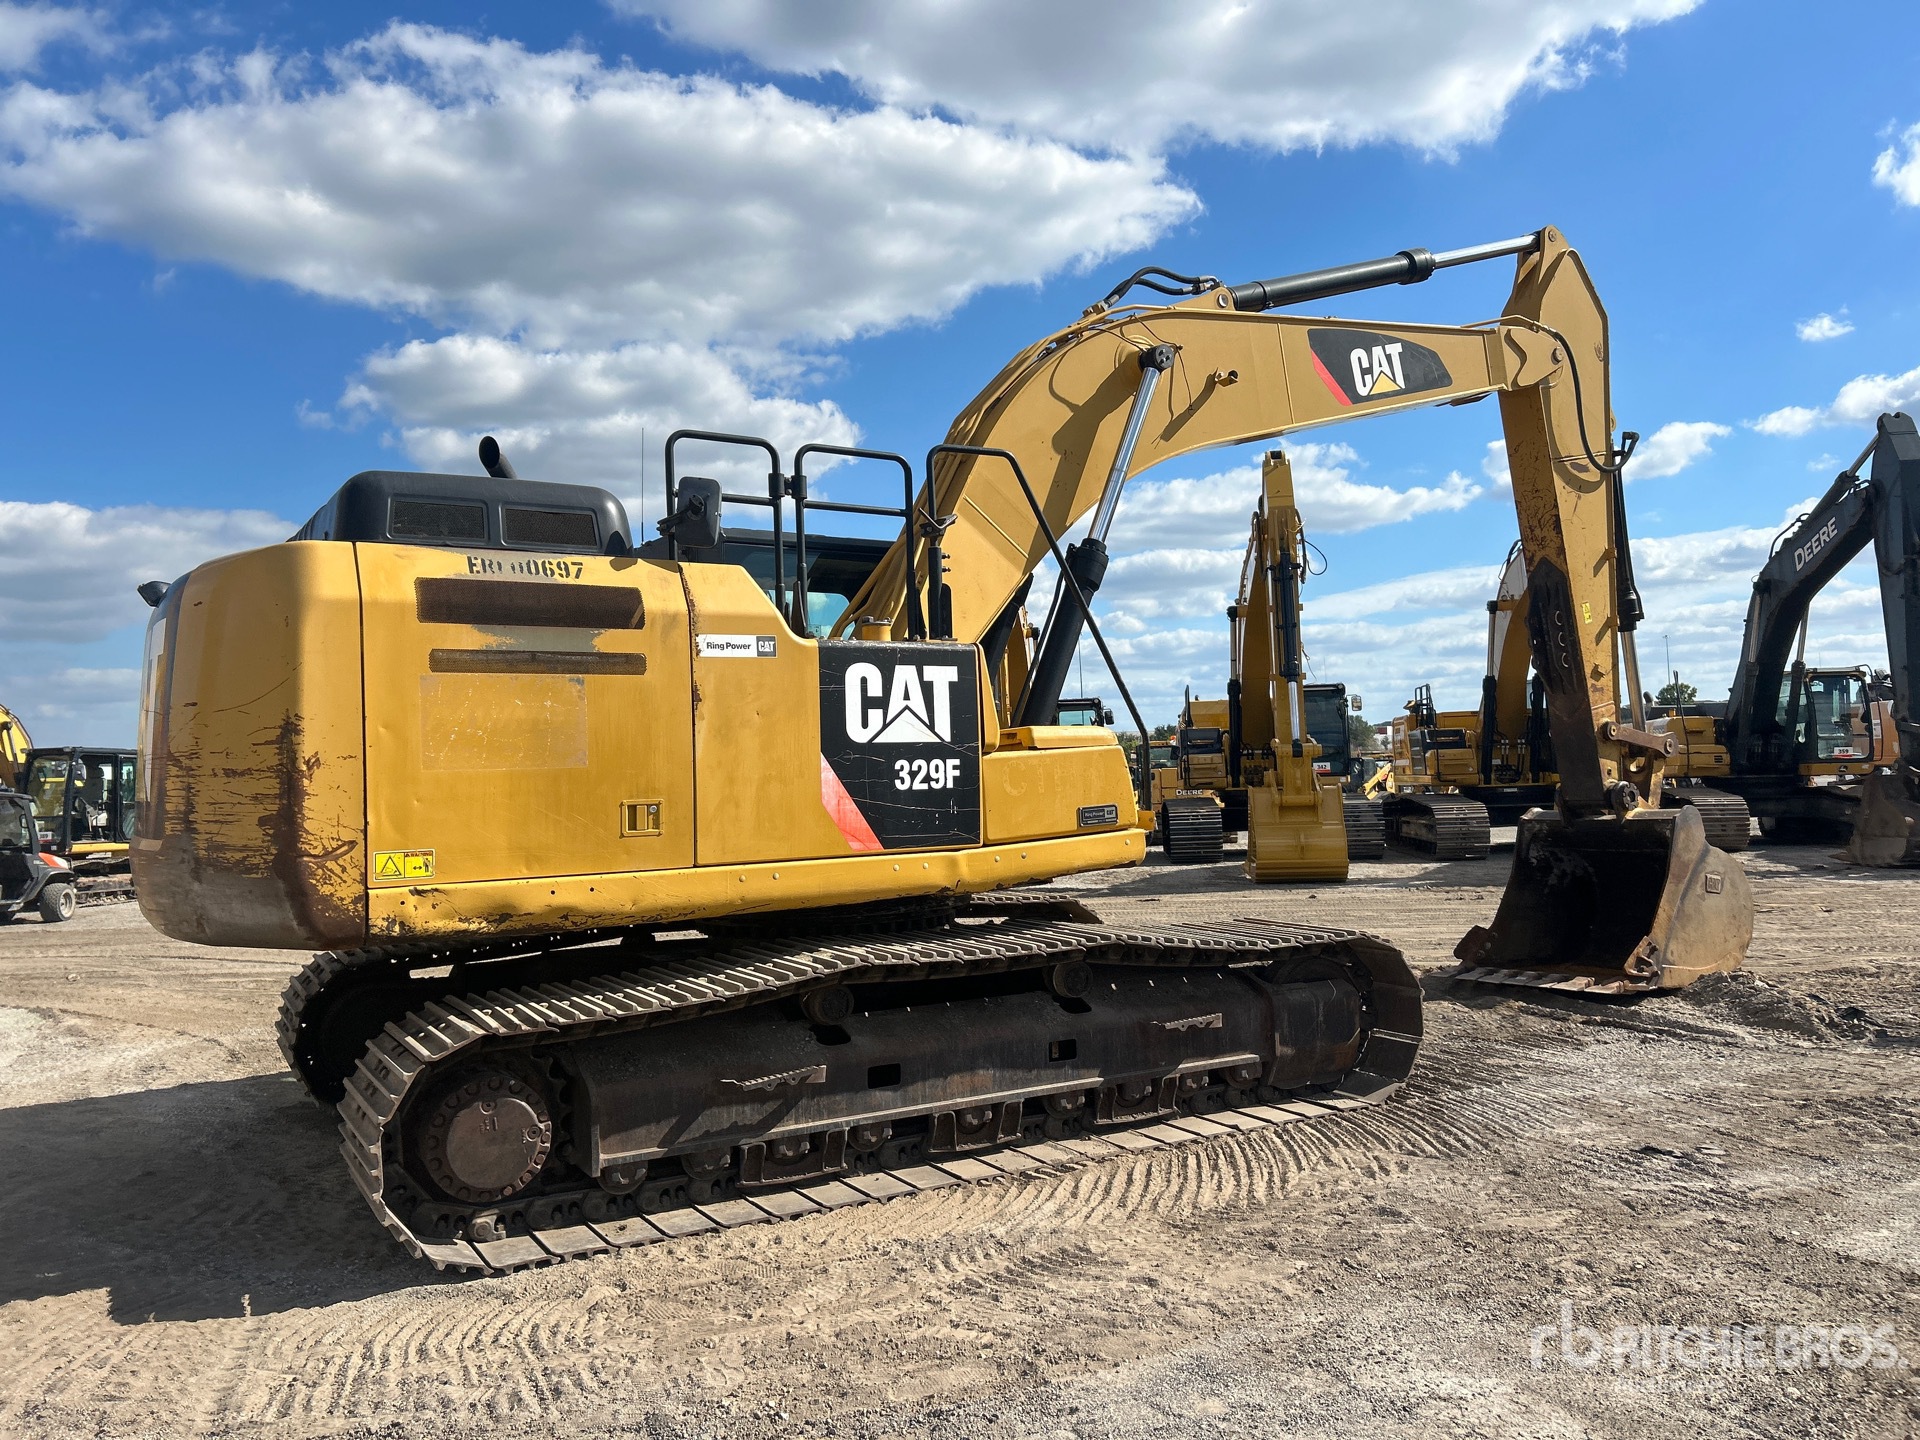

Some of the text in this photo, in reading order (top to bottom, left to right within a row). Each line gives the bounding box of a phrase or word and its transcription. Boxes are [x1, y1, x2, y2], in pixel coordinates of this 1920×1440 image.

[1350, 342, 1406, 397] CAT
[1794, 516, 1838, 571] DEERE
[706, 640, 775, 652] Ring Power CAT
[845, 662, 958, 743] CAT
[894, 758, 961, 791] 329F
